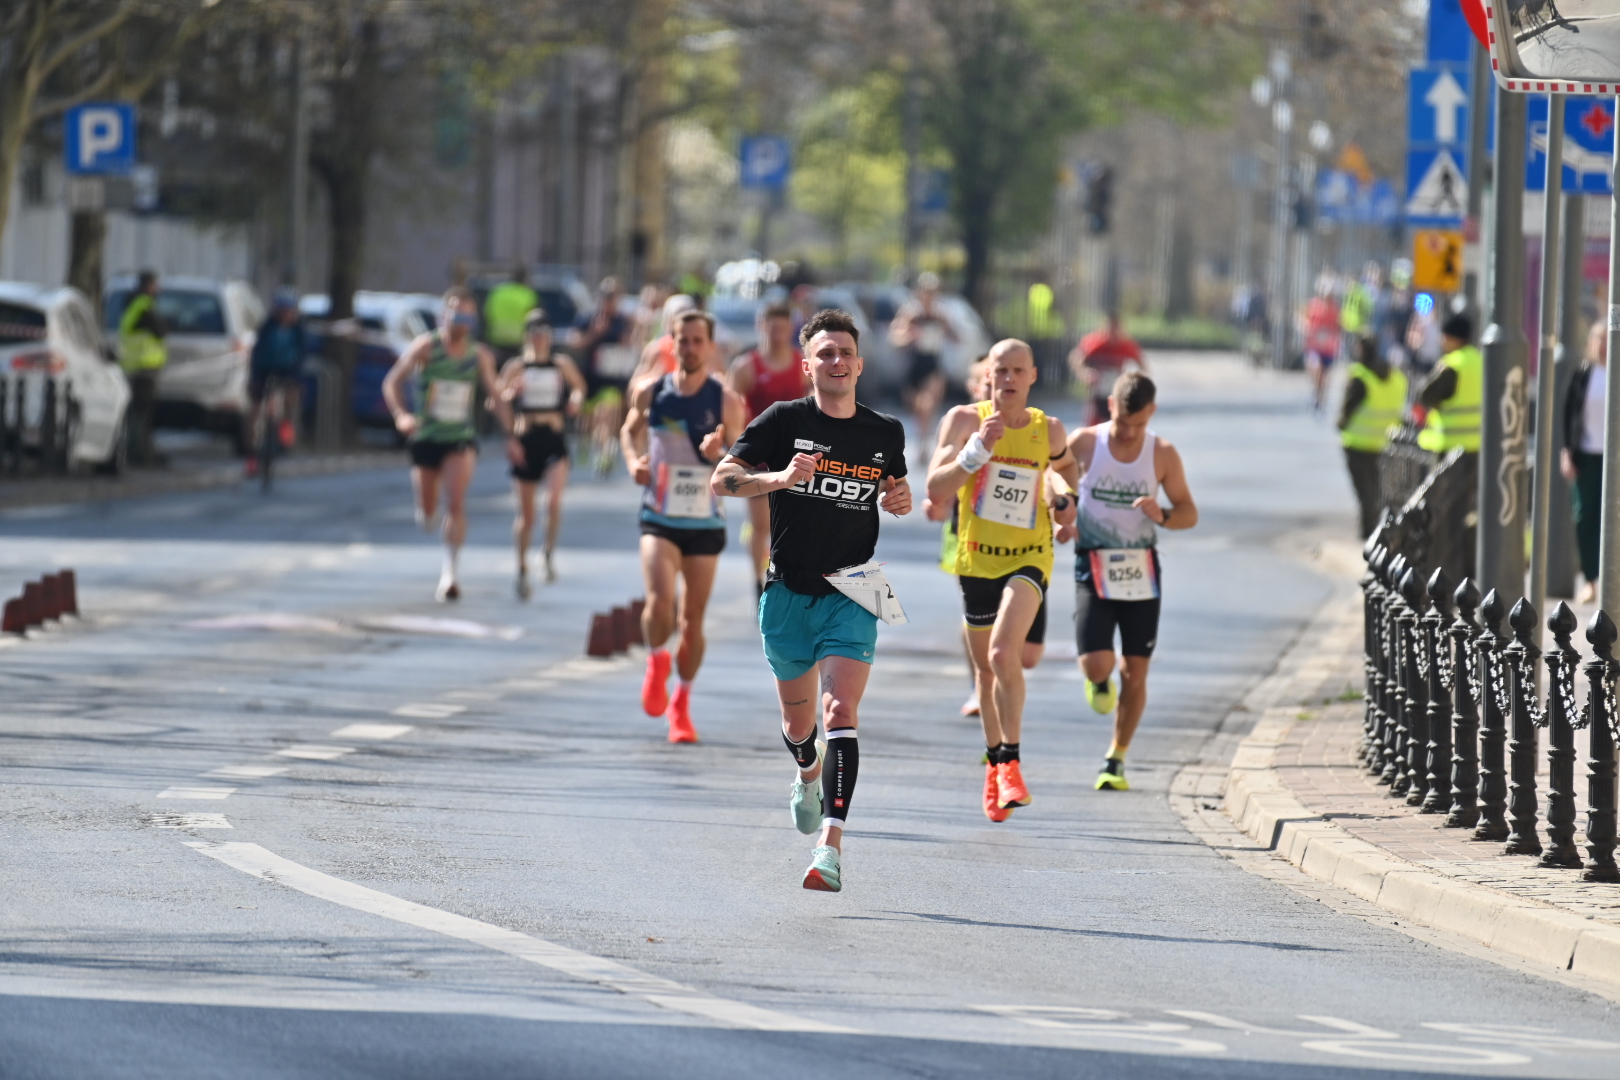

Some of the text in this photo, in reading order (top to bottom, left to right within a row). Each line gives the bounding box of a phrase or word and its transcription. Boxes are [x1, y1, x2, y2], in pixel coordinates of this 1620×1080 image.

[79, 108, 122, 167] P
[815, 459, 881, 480] NISHER
[993, 485, 1028, 504] 5617
[1108, 566, 1143, 582] 8256
